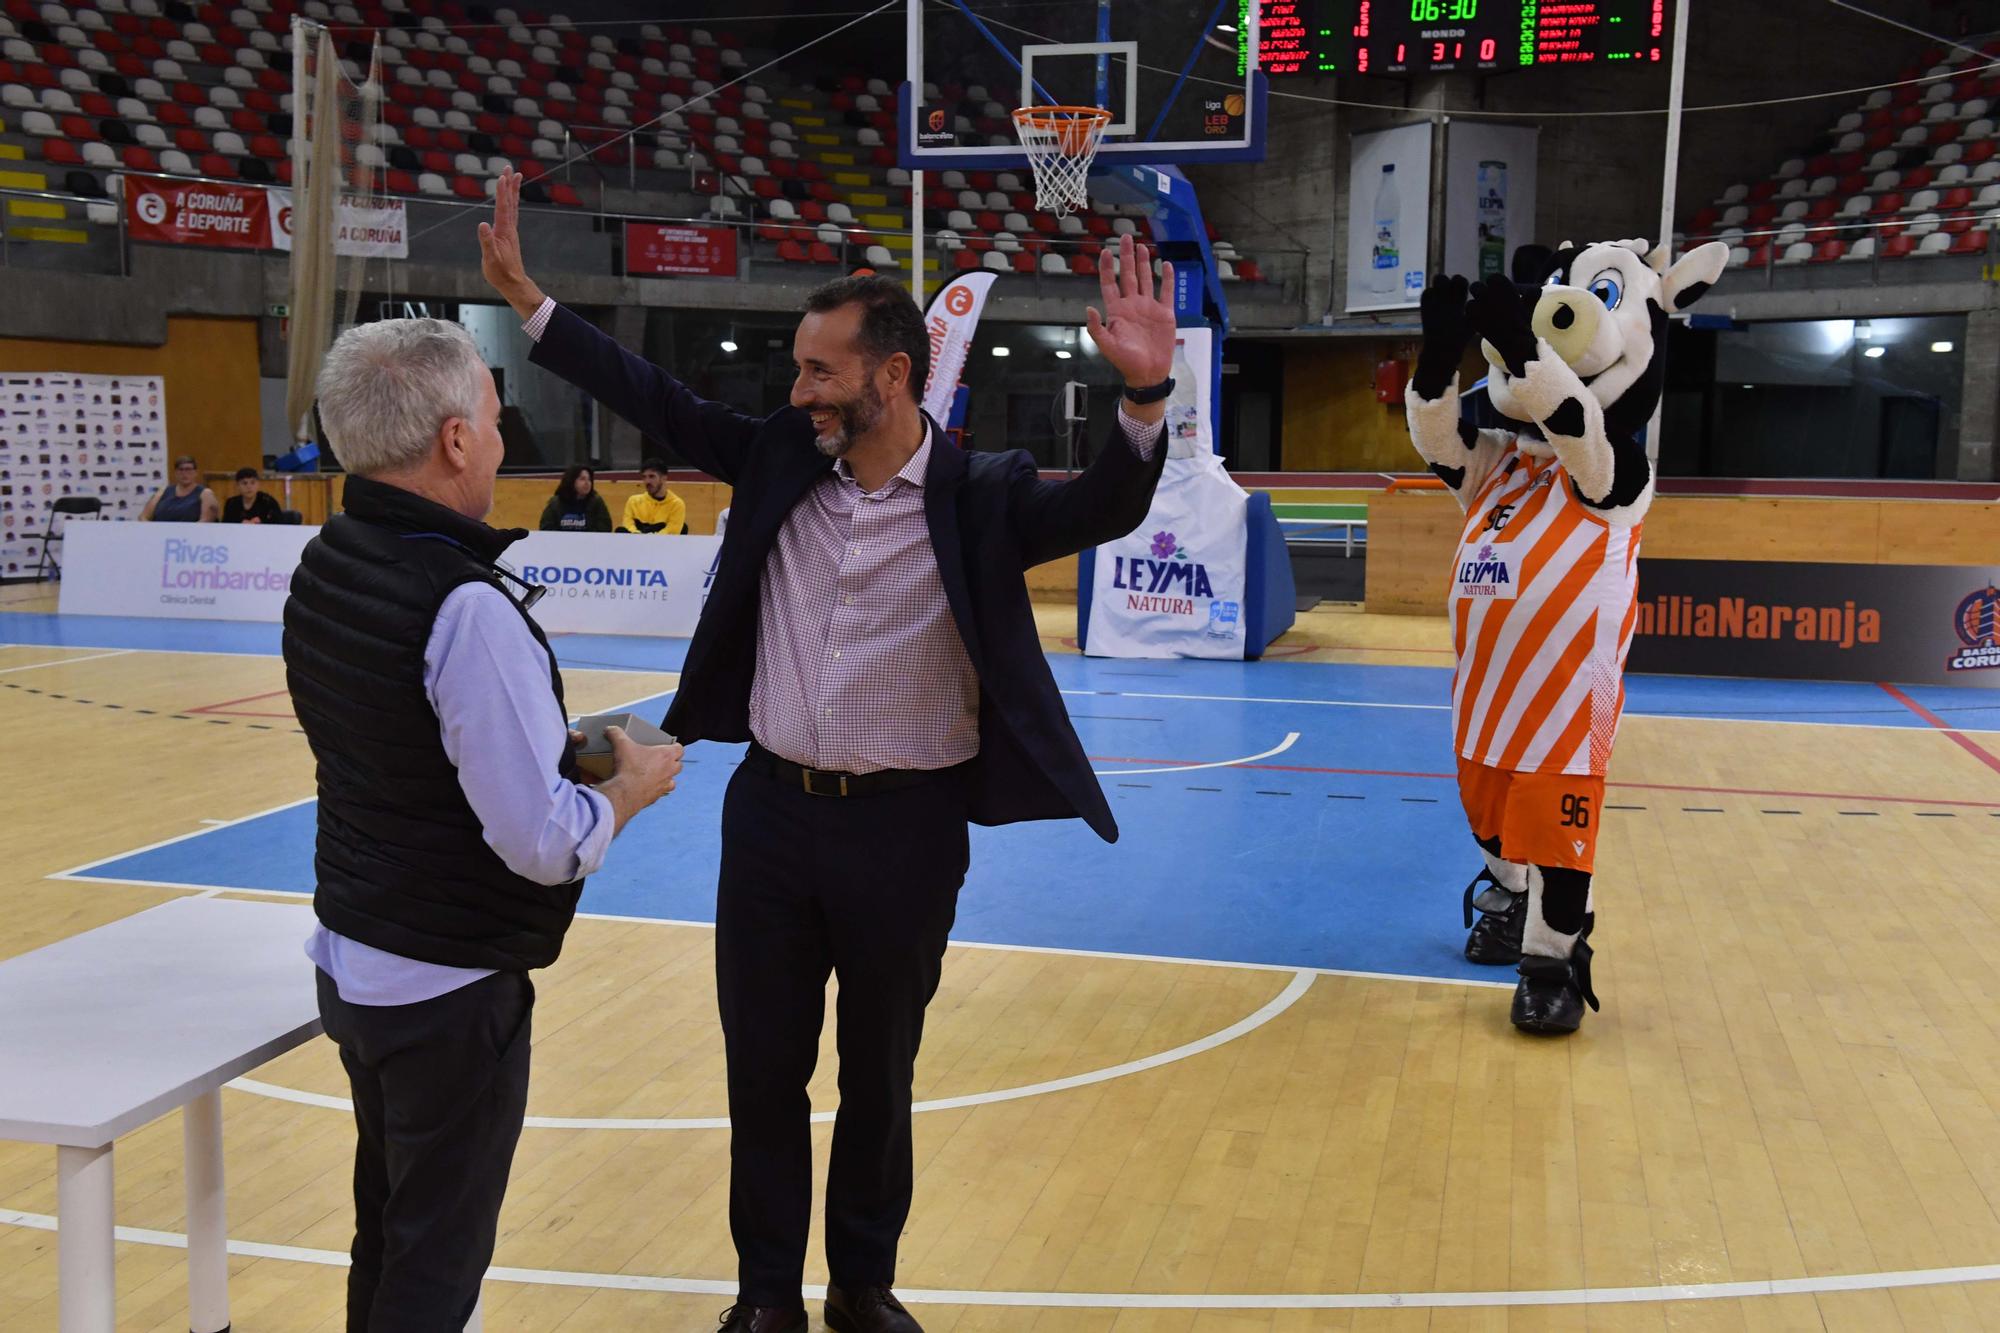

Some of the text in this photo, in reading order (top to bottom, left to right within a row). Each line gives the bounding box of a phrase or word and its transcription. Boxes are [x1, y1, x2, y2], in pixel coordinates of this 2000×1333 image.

[1411, 0, 1477, 21] 06:30
[1421, 29, 1465, 38] MONDO
[1480, 39, 1495, 60] 0
[1205, 100, 1221, 111] Liga
[1205, 114, 1229, 125] LEB
[1205, 126, 1226, 134] ORO
[176, 192, 244, 213] A CORUÑA
[176, 208, 251, 233] É DEPORTE
[340, 225, 402, 244] A CORUÑA
[1178, 271, 1187, 310] MONDO
[165, 538, 229, 564] Rivas
[522, 565, 668, 587] RODONITA
[1113, 556, 1213, 598] LEYMA
[1459, 561, 1510, 583] LEYMA
[1463, 584, 1497, 596] NATURA
[1126, 594, 1193, 615] NATURA
[1560, 793, 1589, 829] 96
